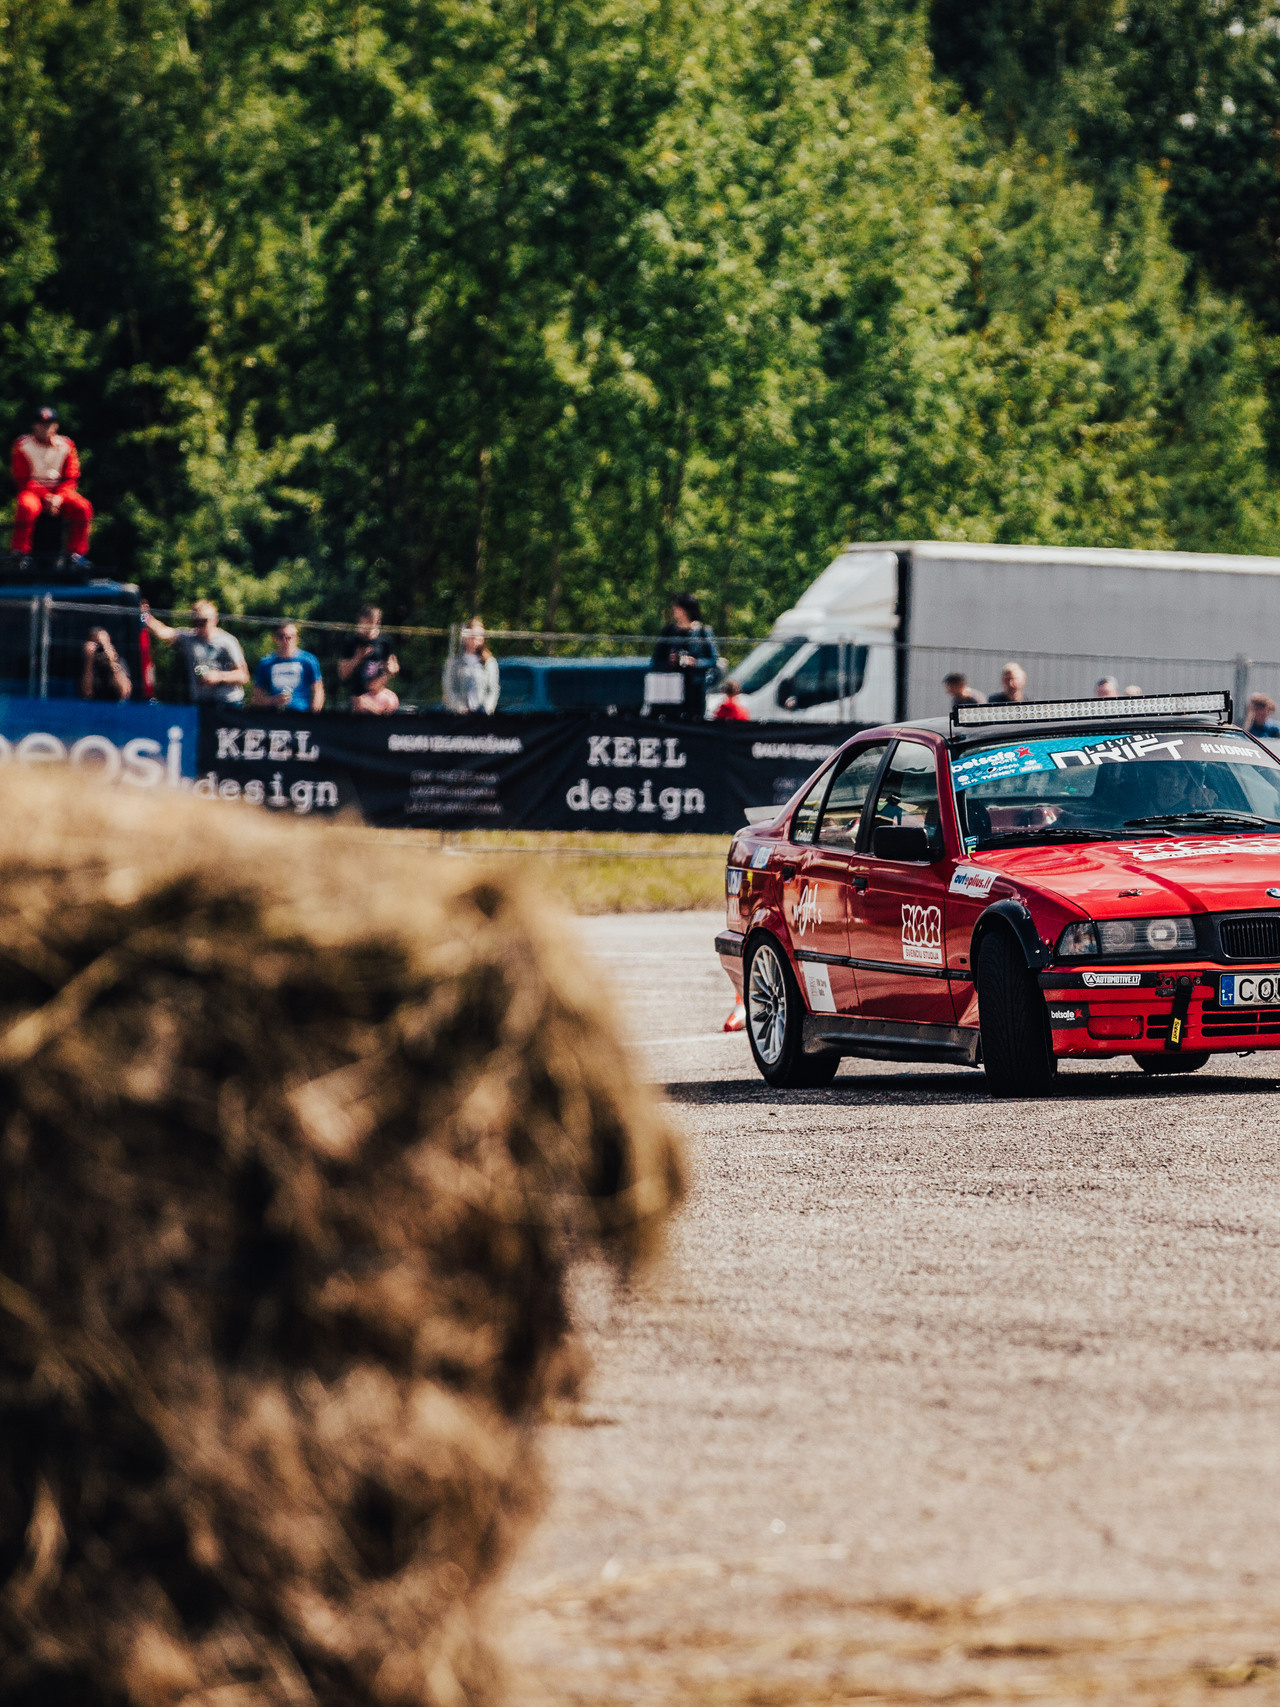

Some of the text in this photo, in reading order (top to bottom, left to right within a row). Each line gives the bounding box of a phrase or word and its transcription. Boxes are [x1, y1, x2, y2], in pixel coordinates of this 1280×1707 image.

[0, 726, 184, 787] epsi
[215, 727, 320, 762] KEEL
[586, 735, 687, 768] KEEL
[1051, 739, 1184, 769] DRIFT
[1084, 732, 1156, 755] Latvian
[1200, 742, 1262, 760] #LVDRIFT
[951, 750, 1016, 774] betsafe
[193, 771, 339, 814] design
[565, 778, 706, 821] design
[1222, 993, 1233, 1001] LT
[1050, 1010, 1075, 1019] betsafe
